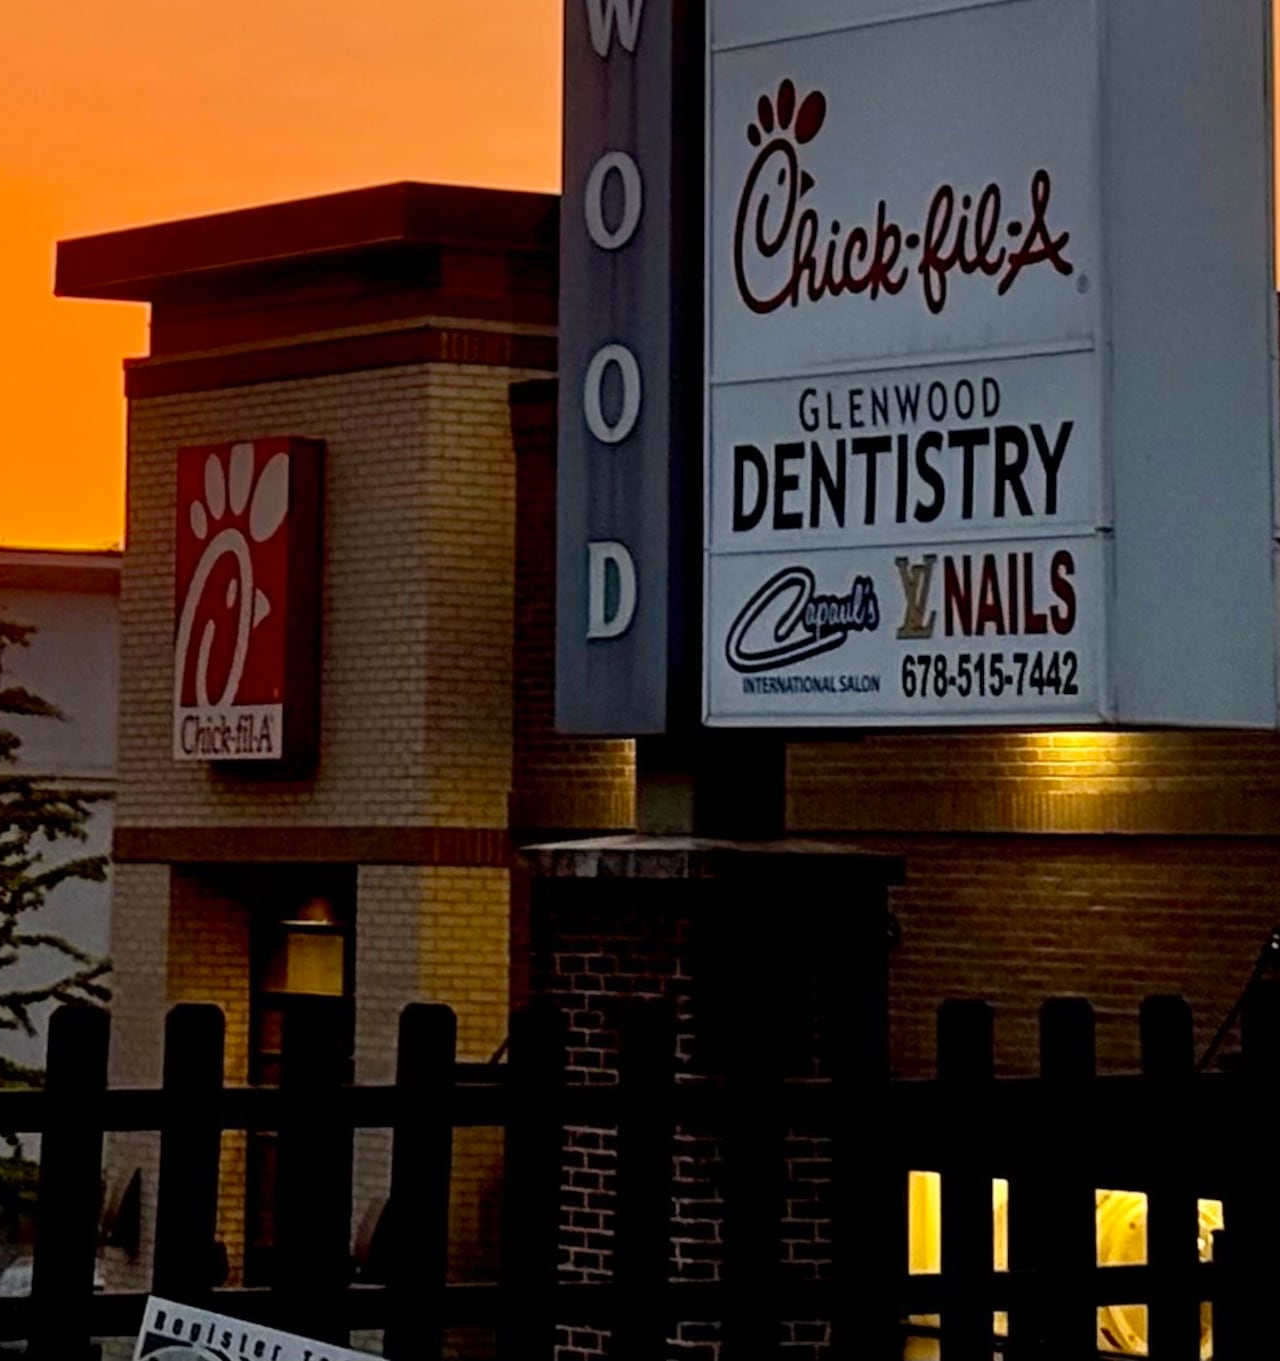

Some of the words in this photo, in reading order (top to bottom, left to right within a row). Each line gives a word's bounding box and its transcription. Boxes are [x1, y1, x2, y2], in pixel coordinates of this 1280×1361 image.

[735, 139, 1073, 314] Chick-fil-A
[799, 377, 1000, 431] GLENWOOD
[732, 421, 1074, 531] DENTISTRY
[944, 550, 1076, 636] NAILS
[742, 676, 837, 694] INTERNATIONAL
[839, 674, 881, 692] SALON
[902, 651, 1078, 697] 678-515-7442
[181, 714, 274, 755] Chick-fil-A
